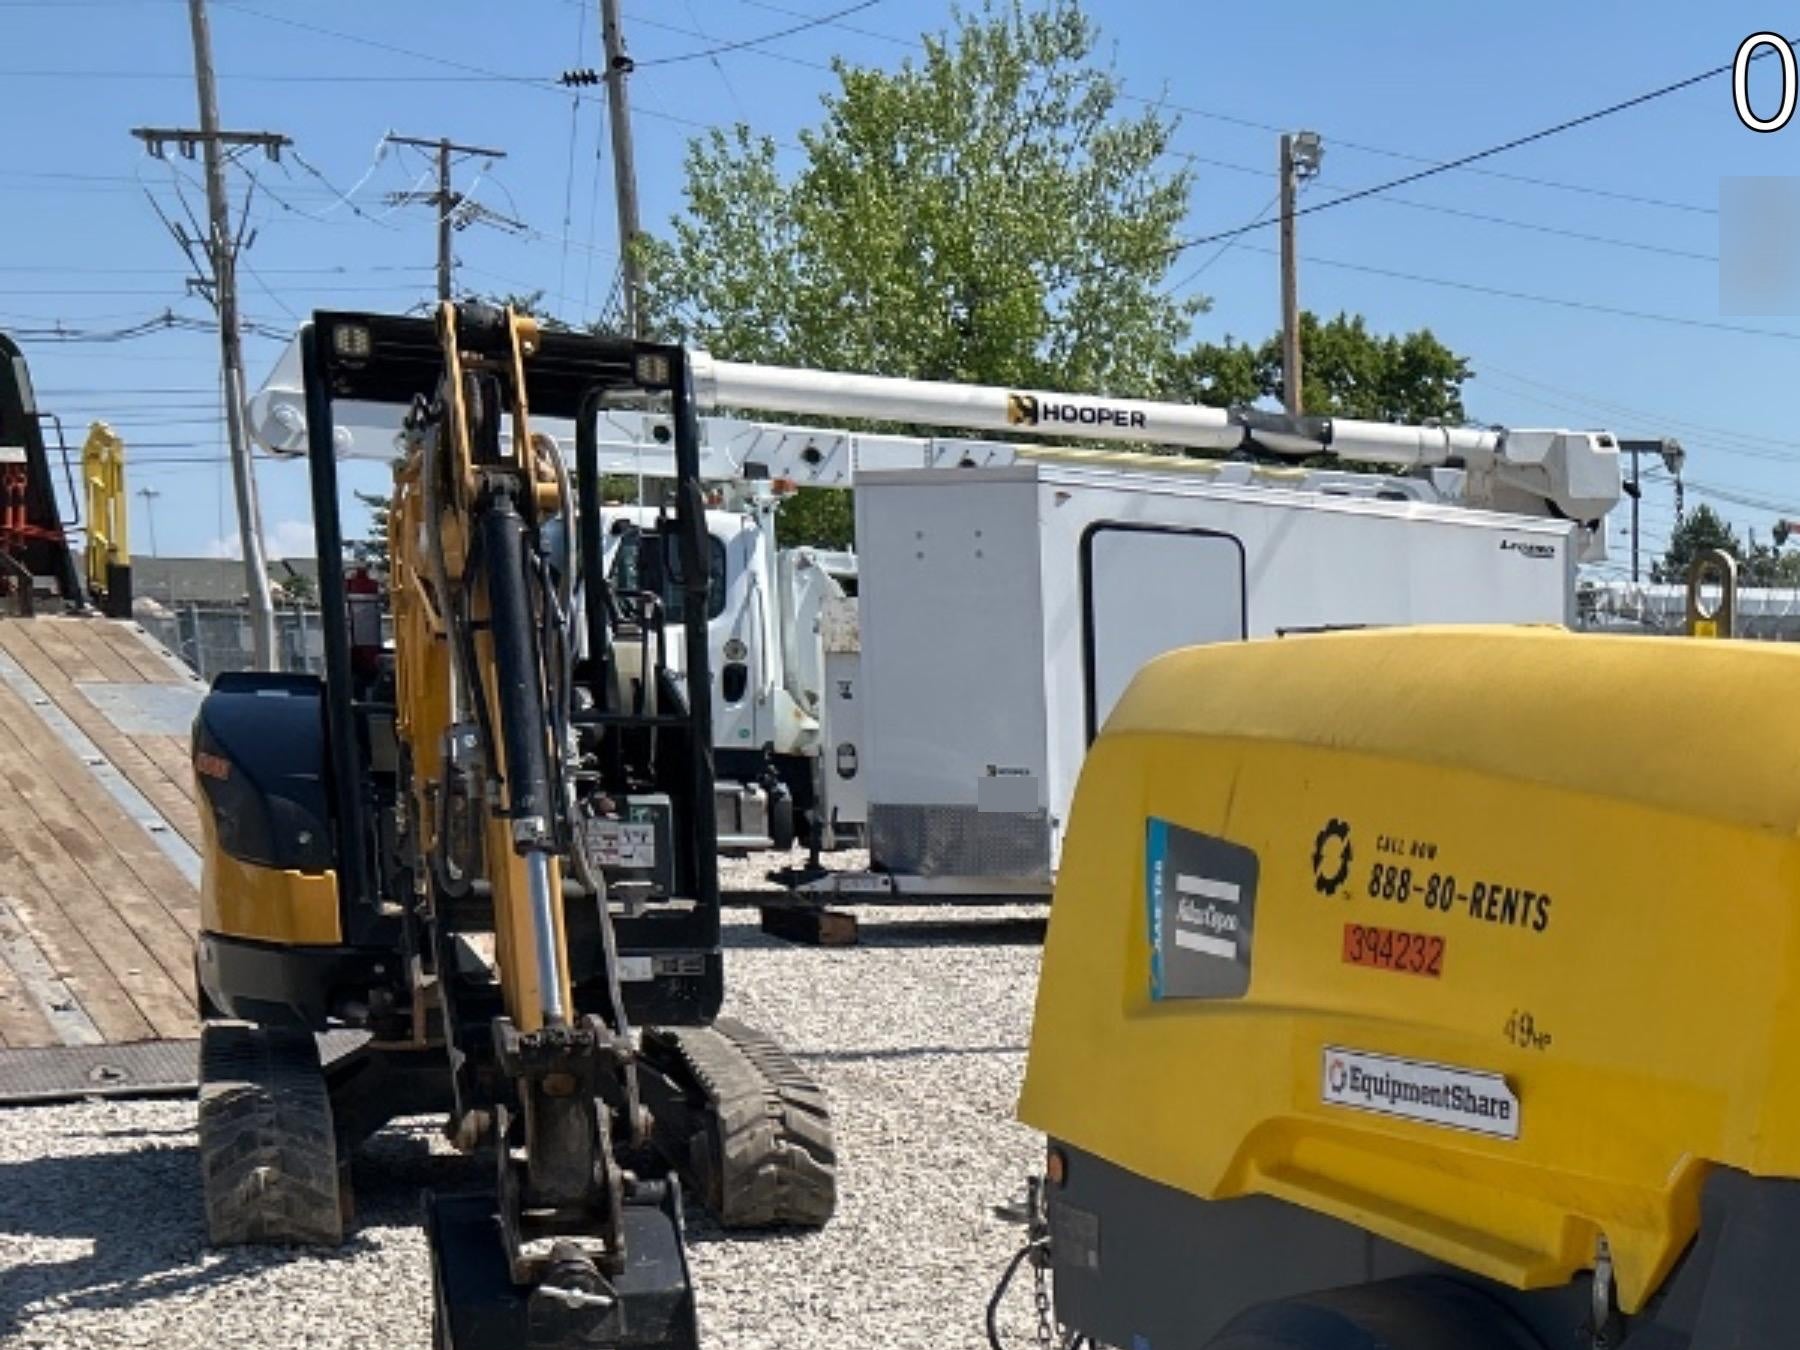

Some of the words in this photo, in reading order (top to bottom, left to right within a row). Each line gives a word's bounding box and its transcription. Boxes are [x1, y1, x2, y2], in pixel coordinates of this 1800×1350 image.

[1043, 402, 1147, 429] HOOPER
[1376, 833, 1405, 855] CALL
[1409, 839, 1439, 861] NOW
[1368, 862, 1552, 932] 888-80-RENTS
[1350, 924, 1445, 977] 394232
[1349, 1066, 1512, 1121] EquipmentShare
